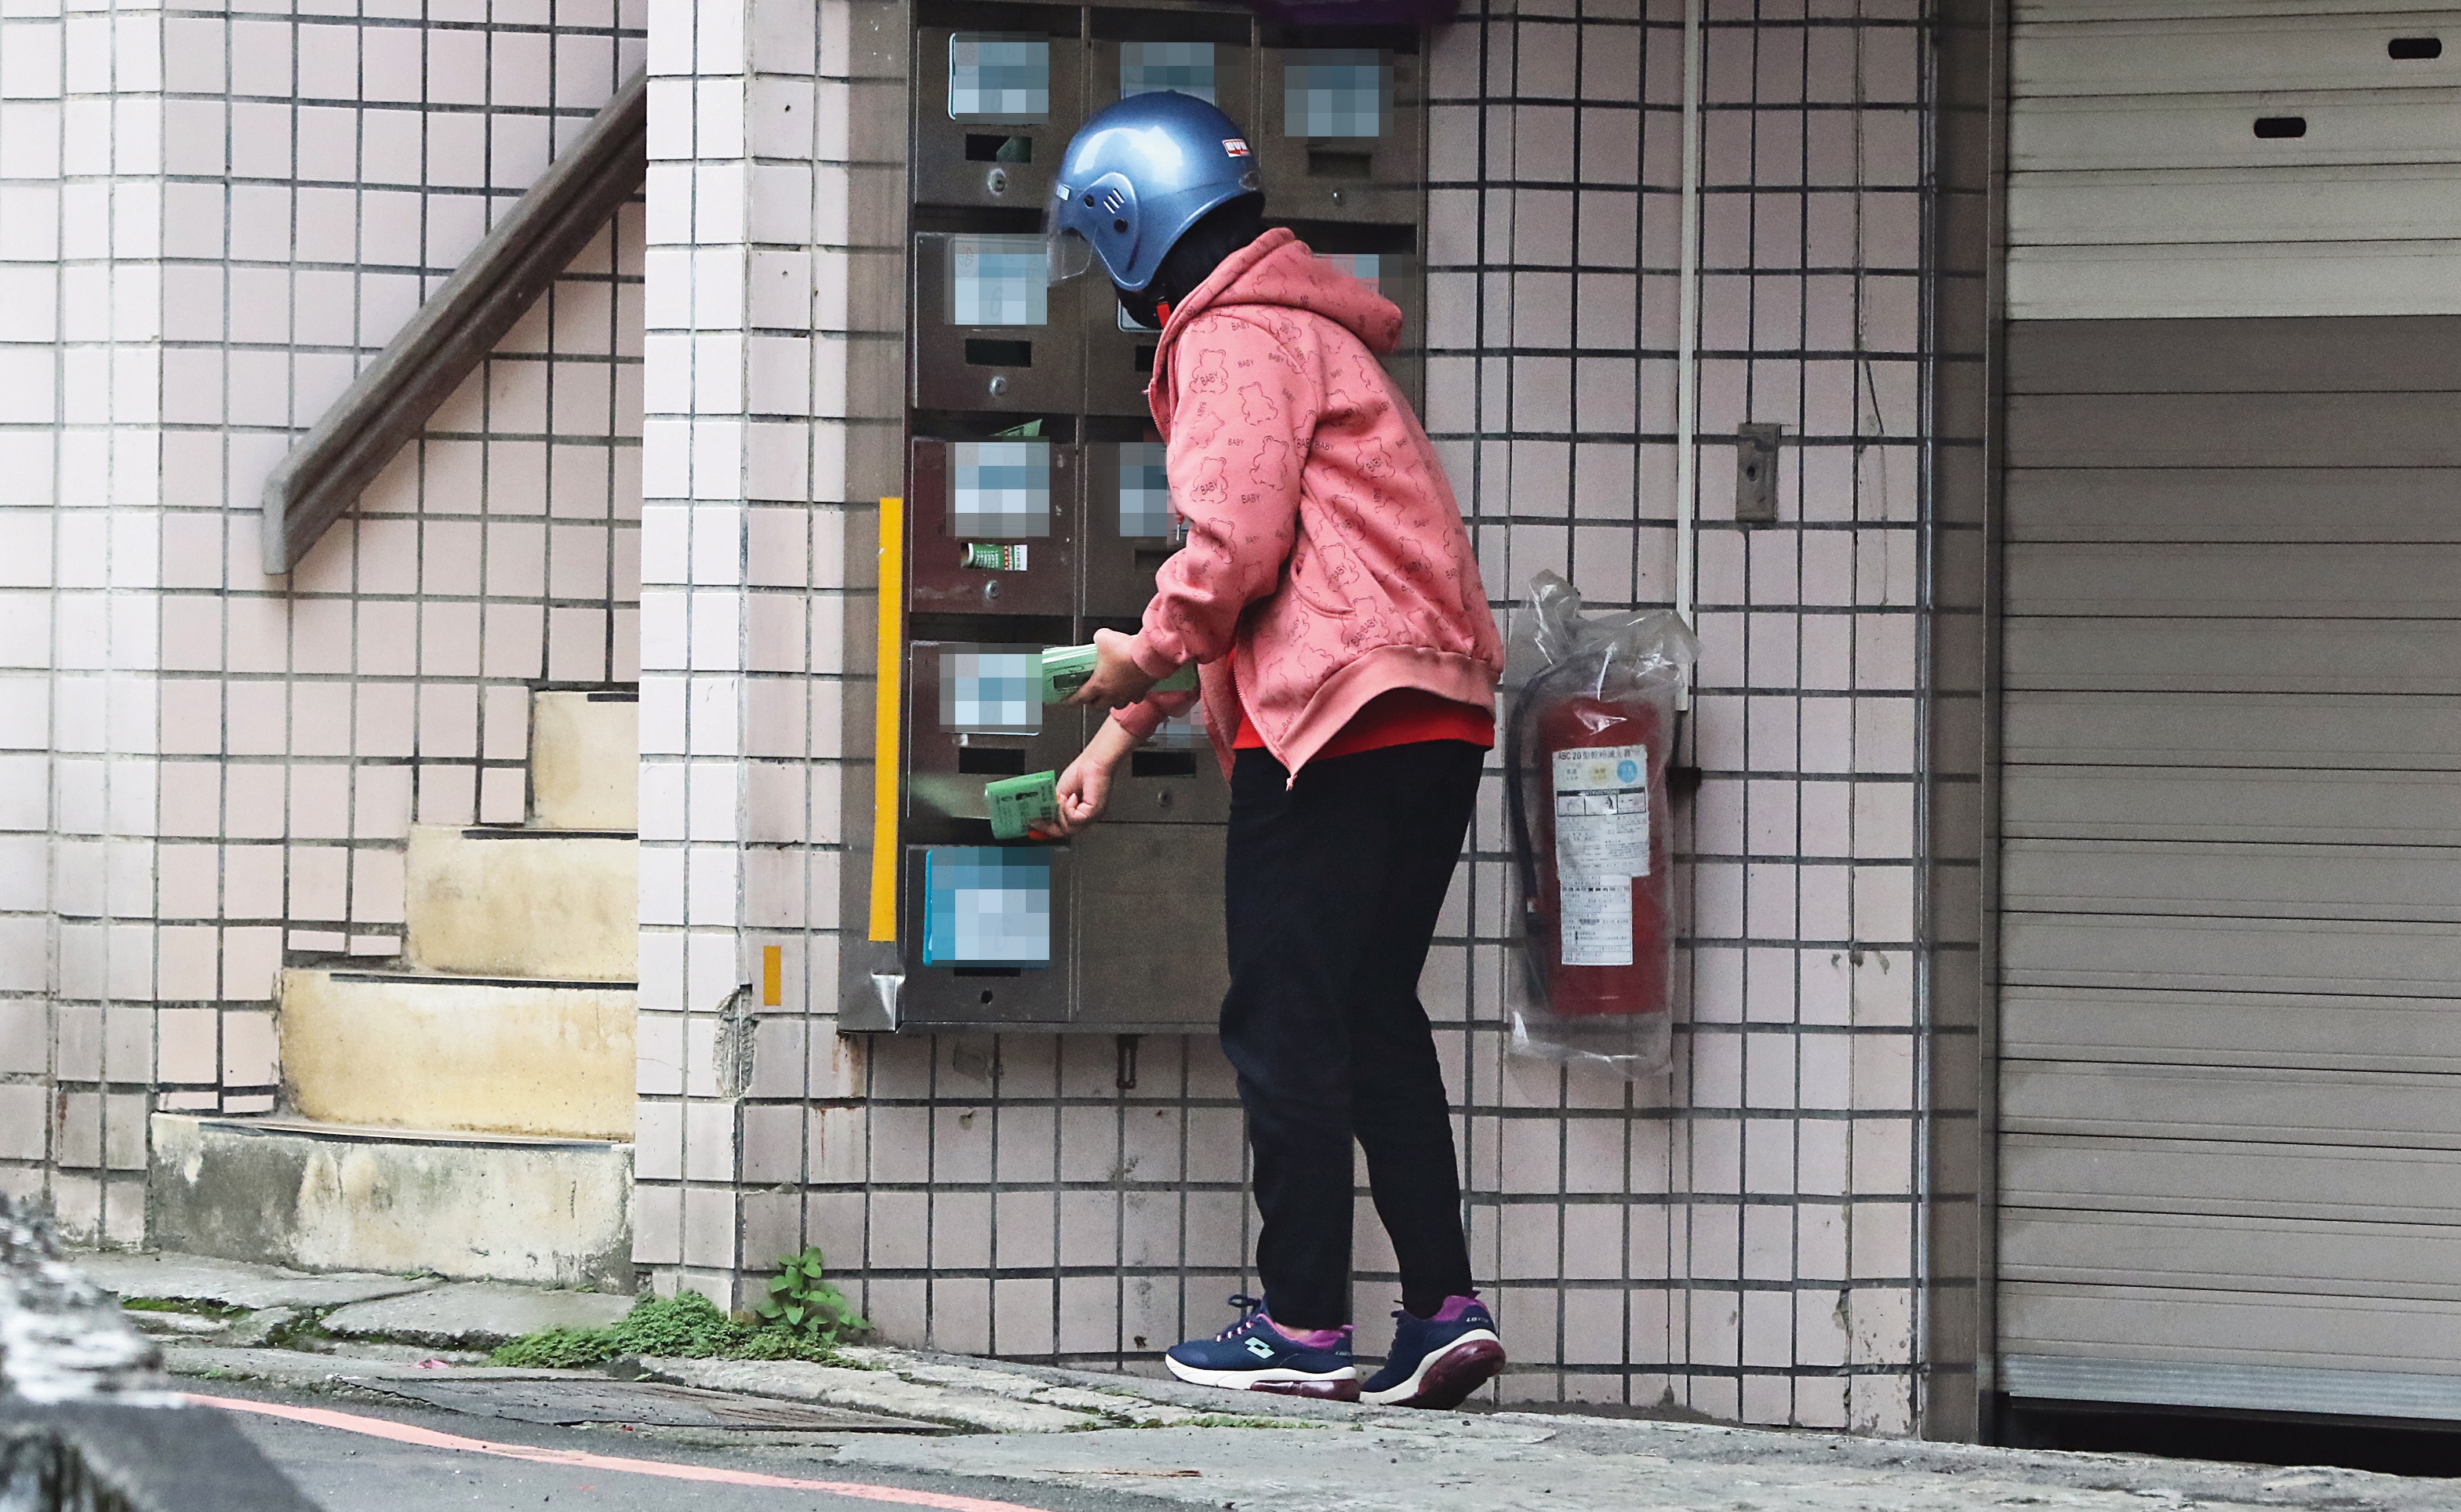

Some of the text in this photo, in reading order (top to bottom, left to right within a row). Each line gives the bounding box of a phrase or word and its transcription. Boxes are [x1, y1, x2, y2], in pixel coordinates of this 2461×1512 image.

[1231, 322, 1249, 331] BABY
[1238, 359, 1254, 368] BABY
[1268, 353, 1285, 363] BABY
[1200, 372, 1219, 386] BABY
[1296, 438, 1310, 449] BAB
[1315, 440, 1334, 451] BABY
[1366, 456, 1383, 472] BABY
[1200, 481, 1219, 496] BABY
[1241, 493, 1260, 504] BABY
[1331, 562, 1348, 582] BABY
[1361, 616, 1378, 634] BABY
[1558, 751, 1571, 760] ABC
[1572, 751, 1582, 760] 20
